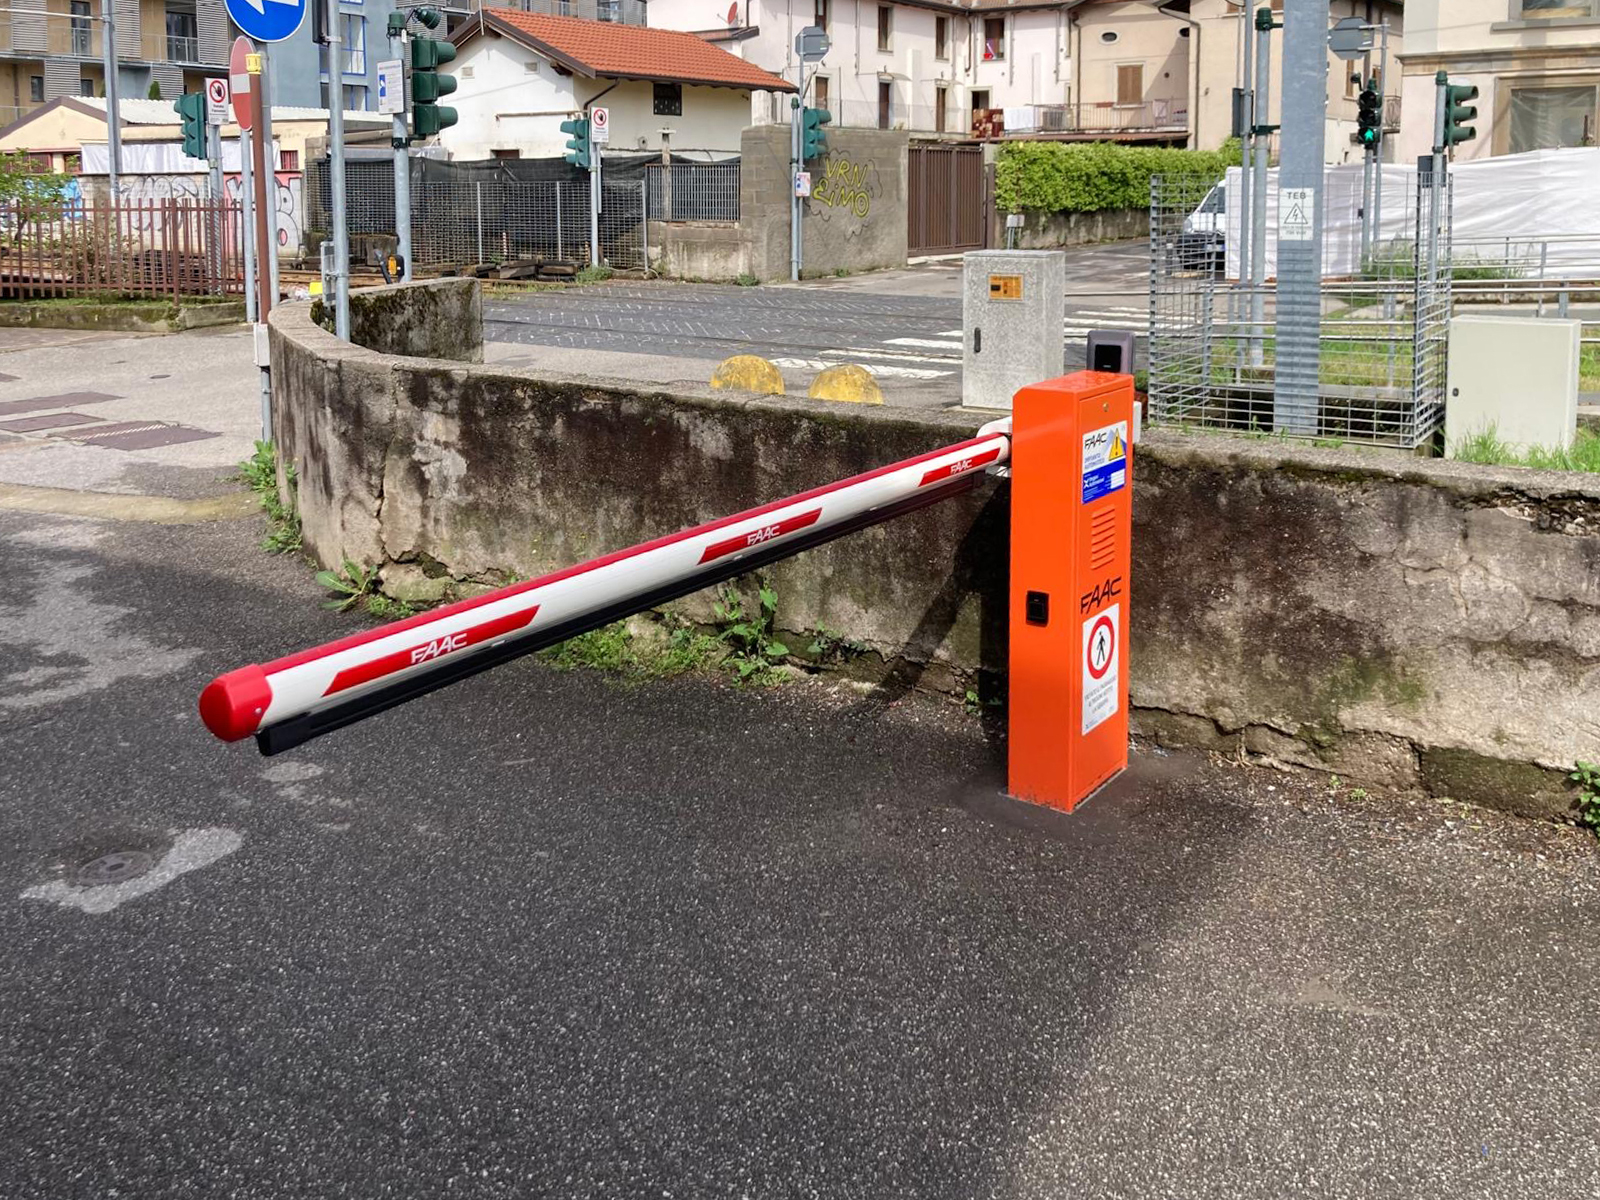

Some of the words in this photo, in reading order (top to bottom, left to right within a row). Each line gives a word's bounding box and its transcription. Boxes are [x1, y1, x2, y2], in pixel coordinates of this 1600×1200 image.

[1287, 191, 1306, 200] TEB
[1084, 432, 1107, 450] FAAC
[950, 459, 972, 475] FAAC
[746, 525, 780, 546] FAAC
[1080, 576, 1122, 615] FAAC
[410, 632, 468, 664] FAAC
